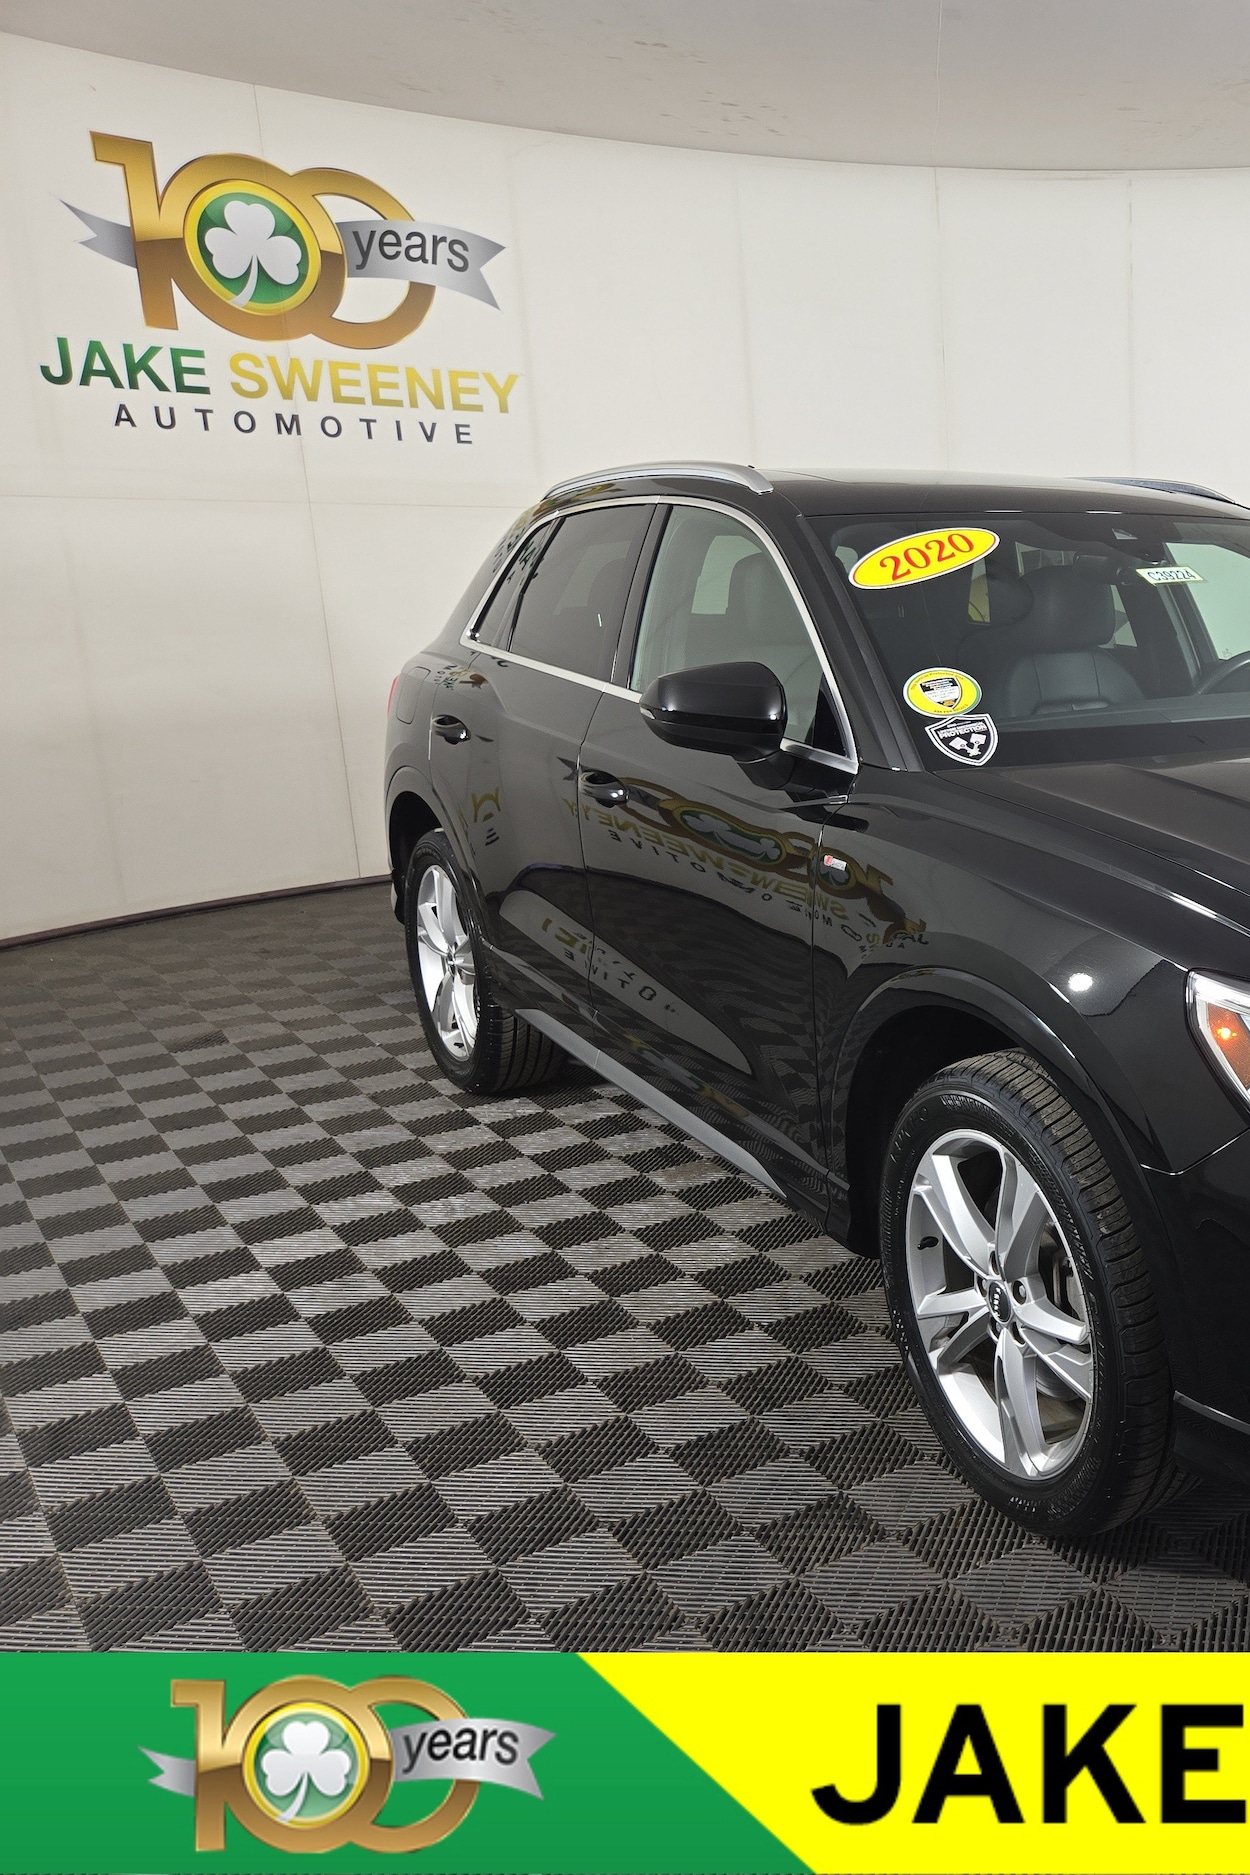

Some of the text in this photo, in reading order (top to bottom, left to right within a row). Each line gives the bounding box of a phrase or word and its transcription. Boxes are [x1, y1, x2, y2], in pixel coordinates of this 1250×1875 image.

[90, 130, 470, 349] 100 years
[40, 337, 519, 414] JAKE SWEENEY
[114, 404, 473, 444] AUTOMOTIVE
[880, 533, 974, 581] 2020
[939, 723, 988, 739] PROTECTION
